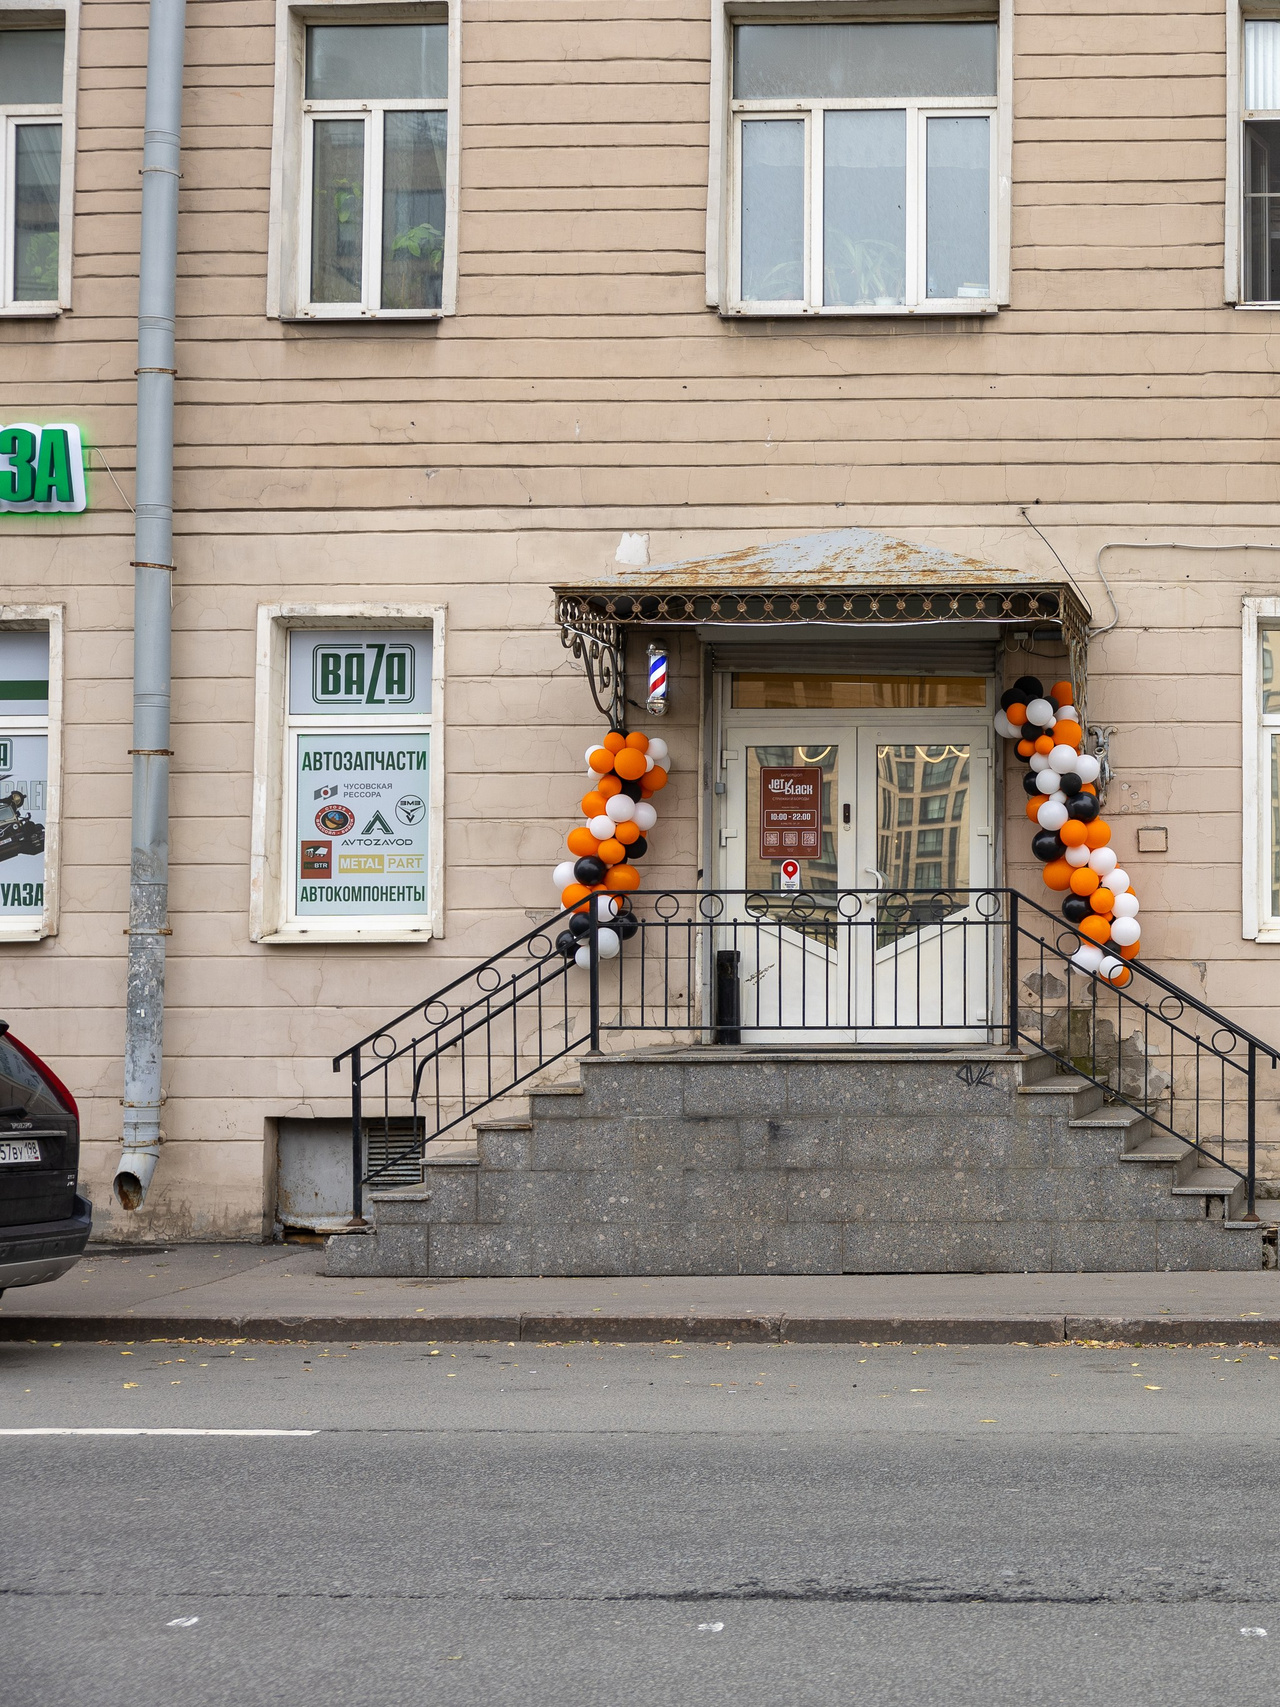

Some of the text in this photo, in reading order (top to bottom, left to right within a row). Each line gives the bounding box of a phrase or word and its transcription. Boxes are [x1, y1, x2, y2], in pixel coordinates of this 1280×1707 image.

[321, 643, 406, 704] BAZA
[302, 751, 427, 771] АВТОЗАПЧАСТИ
[341, 838, 413, 846] AVTOZAVOD
[340, 857, 423, 869] METAL PART
[0, 883, 44, 907] УАЗА
[300, 885, 425, 902] АВТОКОМПОНЕНТЫ
